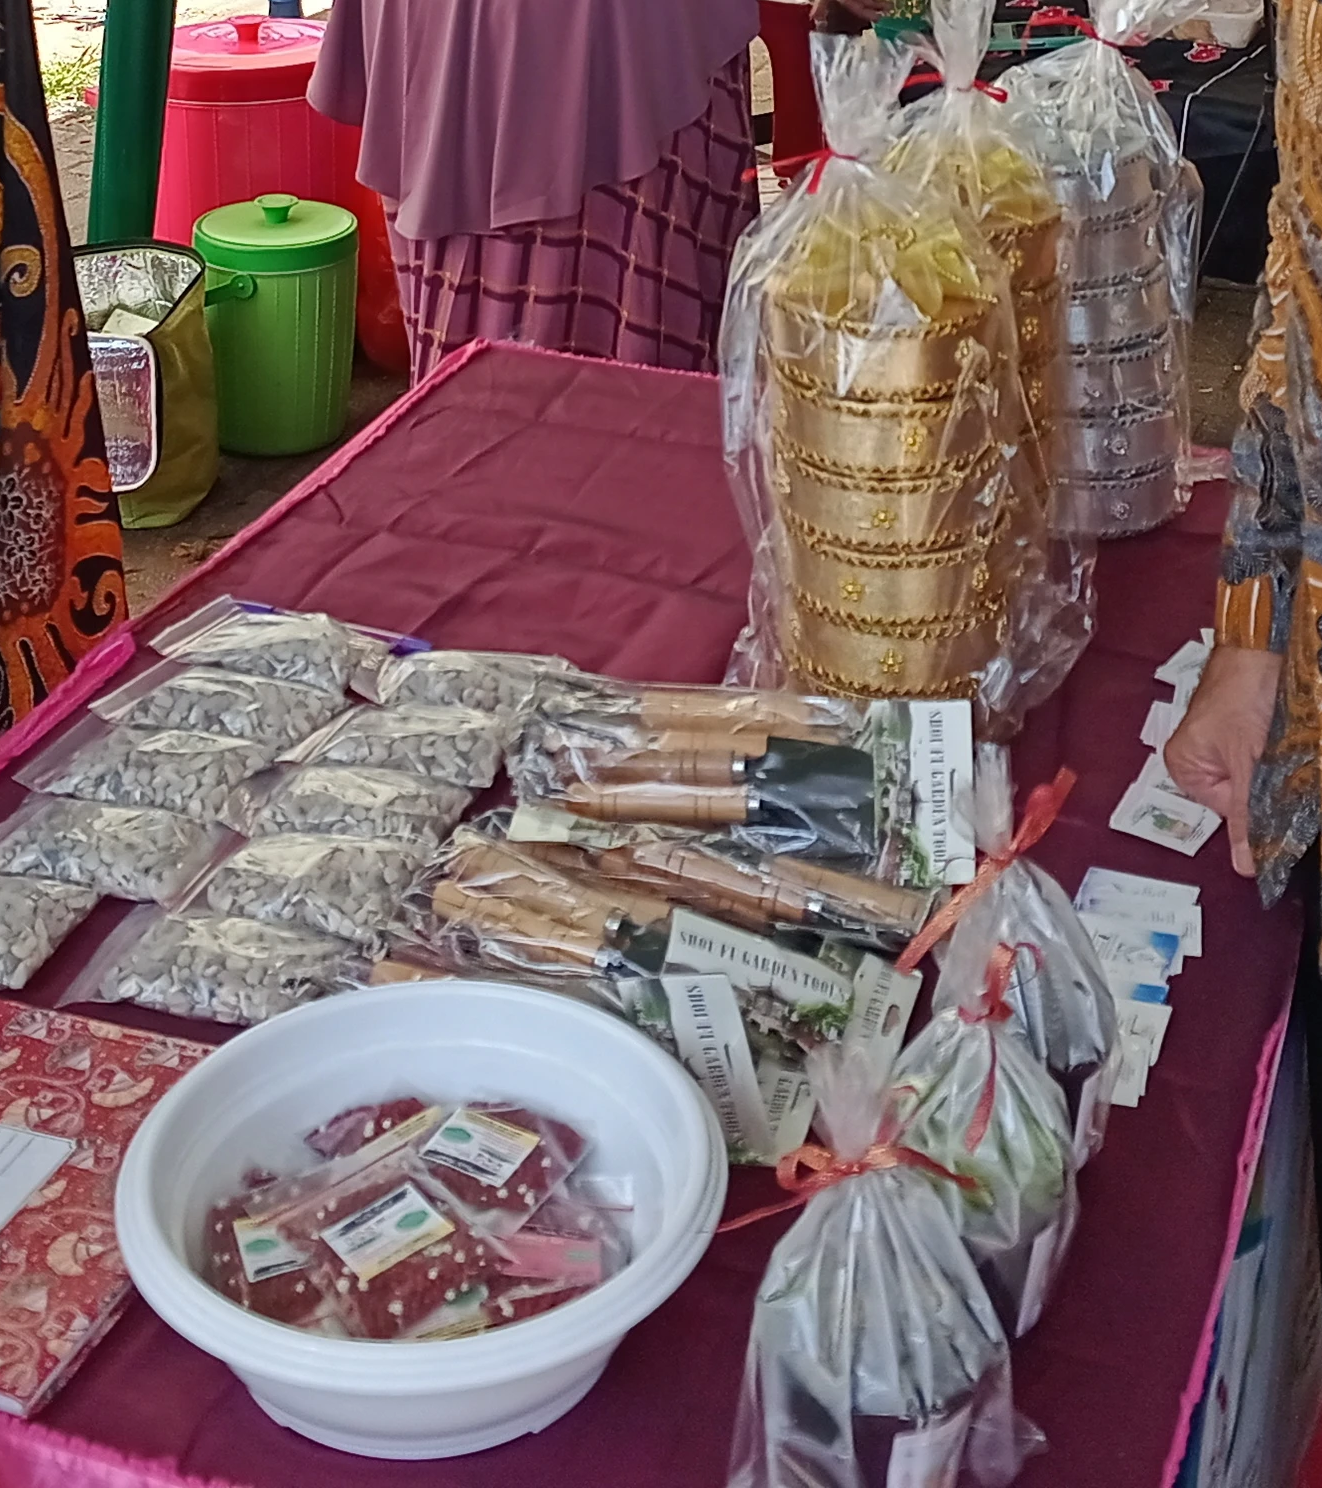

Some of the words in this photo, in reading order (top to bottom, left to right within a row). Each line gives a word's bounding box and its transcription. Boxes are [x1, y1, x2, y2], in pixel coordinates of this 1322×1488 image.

[930, 770, 947, 826] GARDEN
[742, 950, 800, 986] GARDEN
[802, 972, 848, 1006] TOOLS
[701, 1045, 732, 1102] GARDEN
